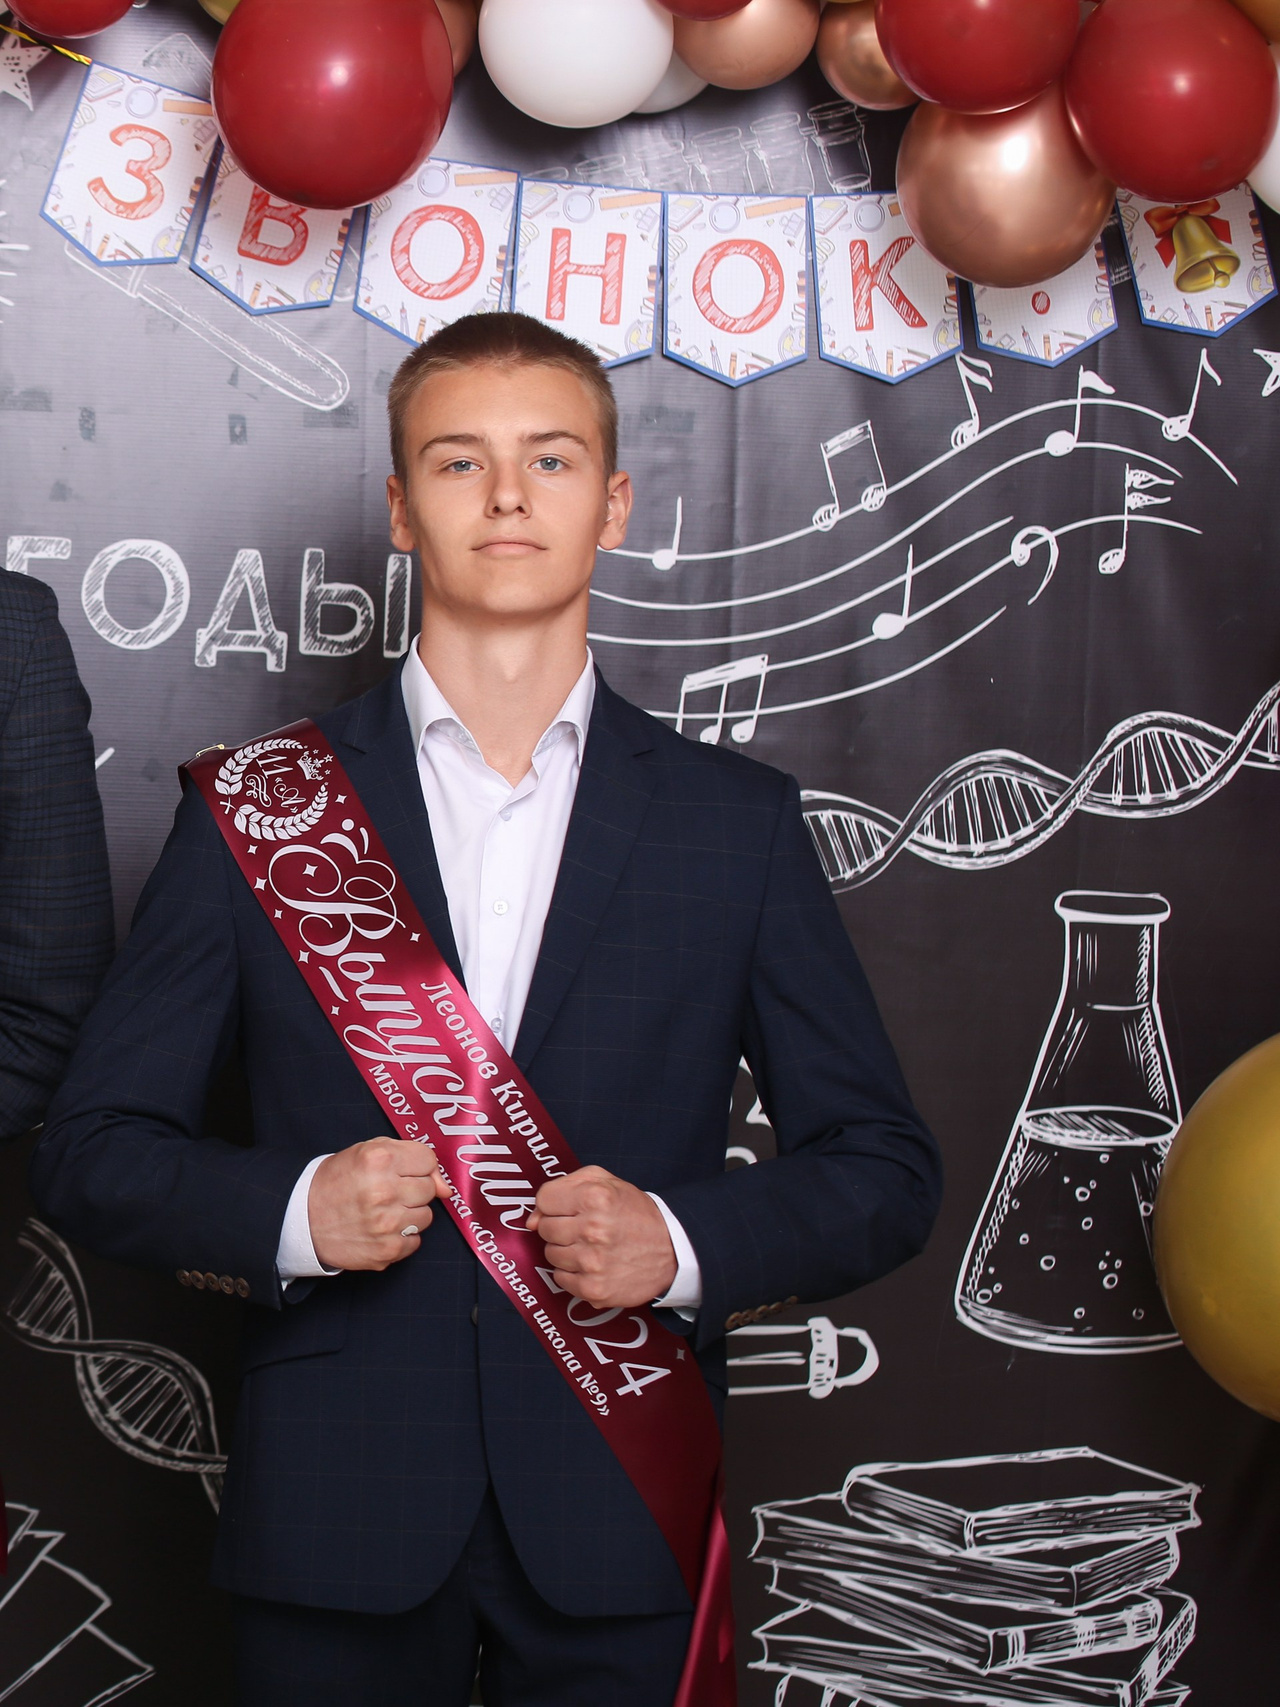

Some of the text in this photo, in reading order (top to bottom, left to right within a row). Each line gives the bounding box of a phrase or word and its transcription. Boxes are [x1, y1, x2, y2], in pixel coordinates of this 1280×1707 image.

[268, 832, 537, 1232] Выпускник
[421, 981, 498, 1080] Леонов
[368, 1063, 415, 1117] МБОУ
[468, 1221, 538, 1309] «Средняя
[532, 1308, 577, 1373] школа
[575, 1371, 610, 1416] №9»
